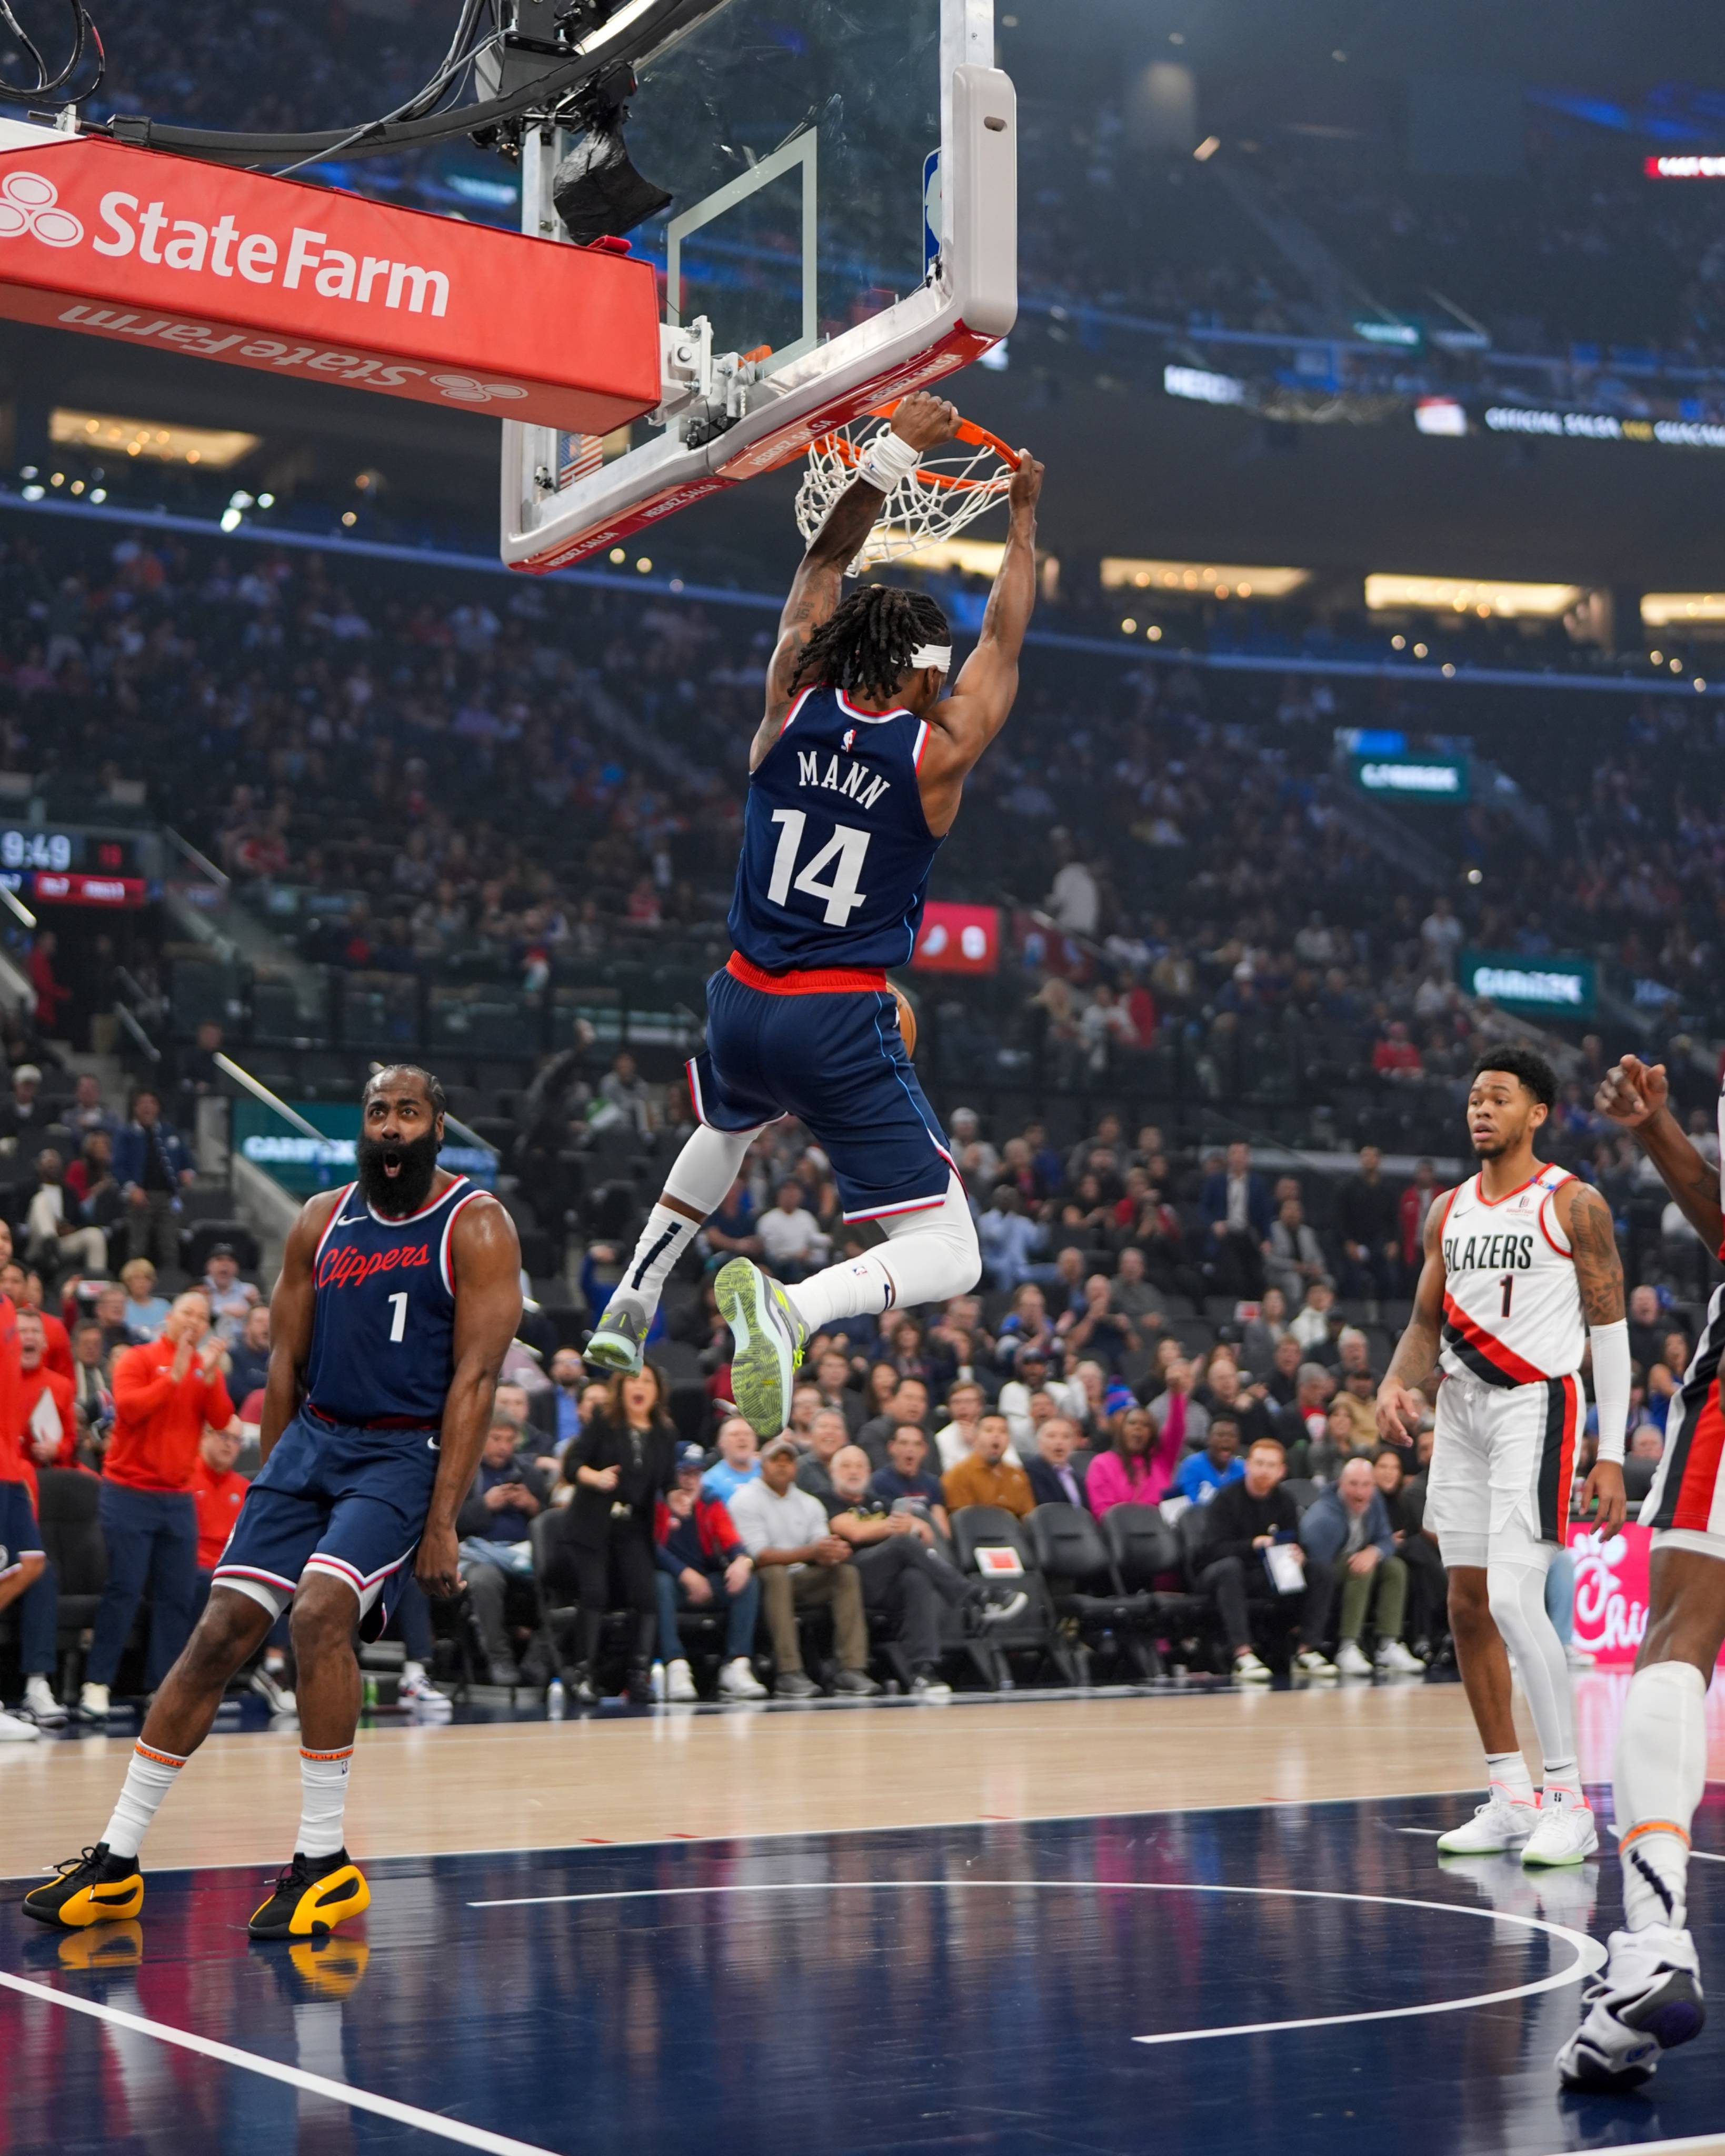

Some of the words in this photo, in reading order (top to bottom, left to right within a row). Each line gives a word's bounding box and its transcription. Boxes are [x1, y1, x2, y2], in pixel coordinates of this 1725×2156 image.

[914, 353, 963, 377] SALSA
[749, 440, 797, 466] HERDEZ
[791, 420, 837, 440] SALSA
[641, 496, 686, 517] HERDEZ
[681, 484, 723, 499] SALSA
[544, 547, 585, 567] HERDEZ
[580, 532, 620, 549] SALSA
[797, 751, 891, 810] MANN
[767, 809, 871, 927] 14
[318, 1244, 430, 1288] Clippers
[1444, 1234, 1533, 1273] BLAZERS
[388, 1292, 408, 1342] 1
[1500, 1274, 1513, 1317] 1
